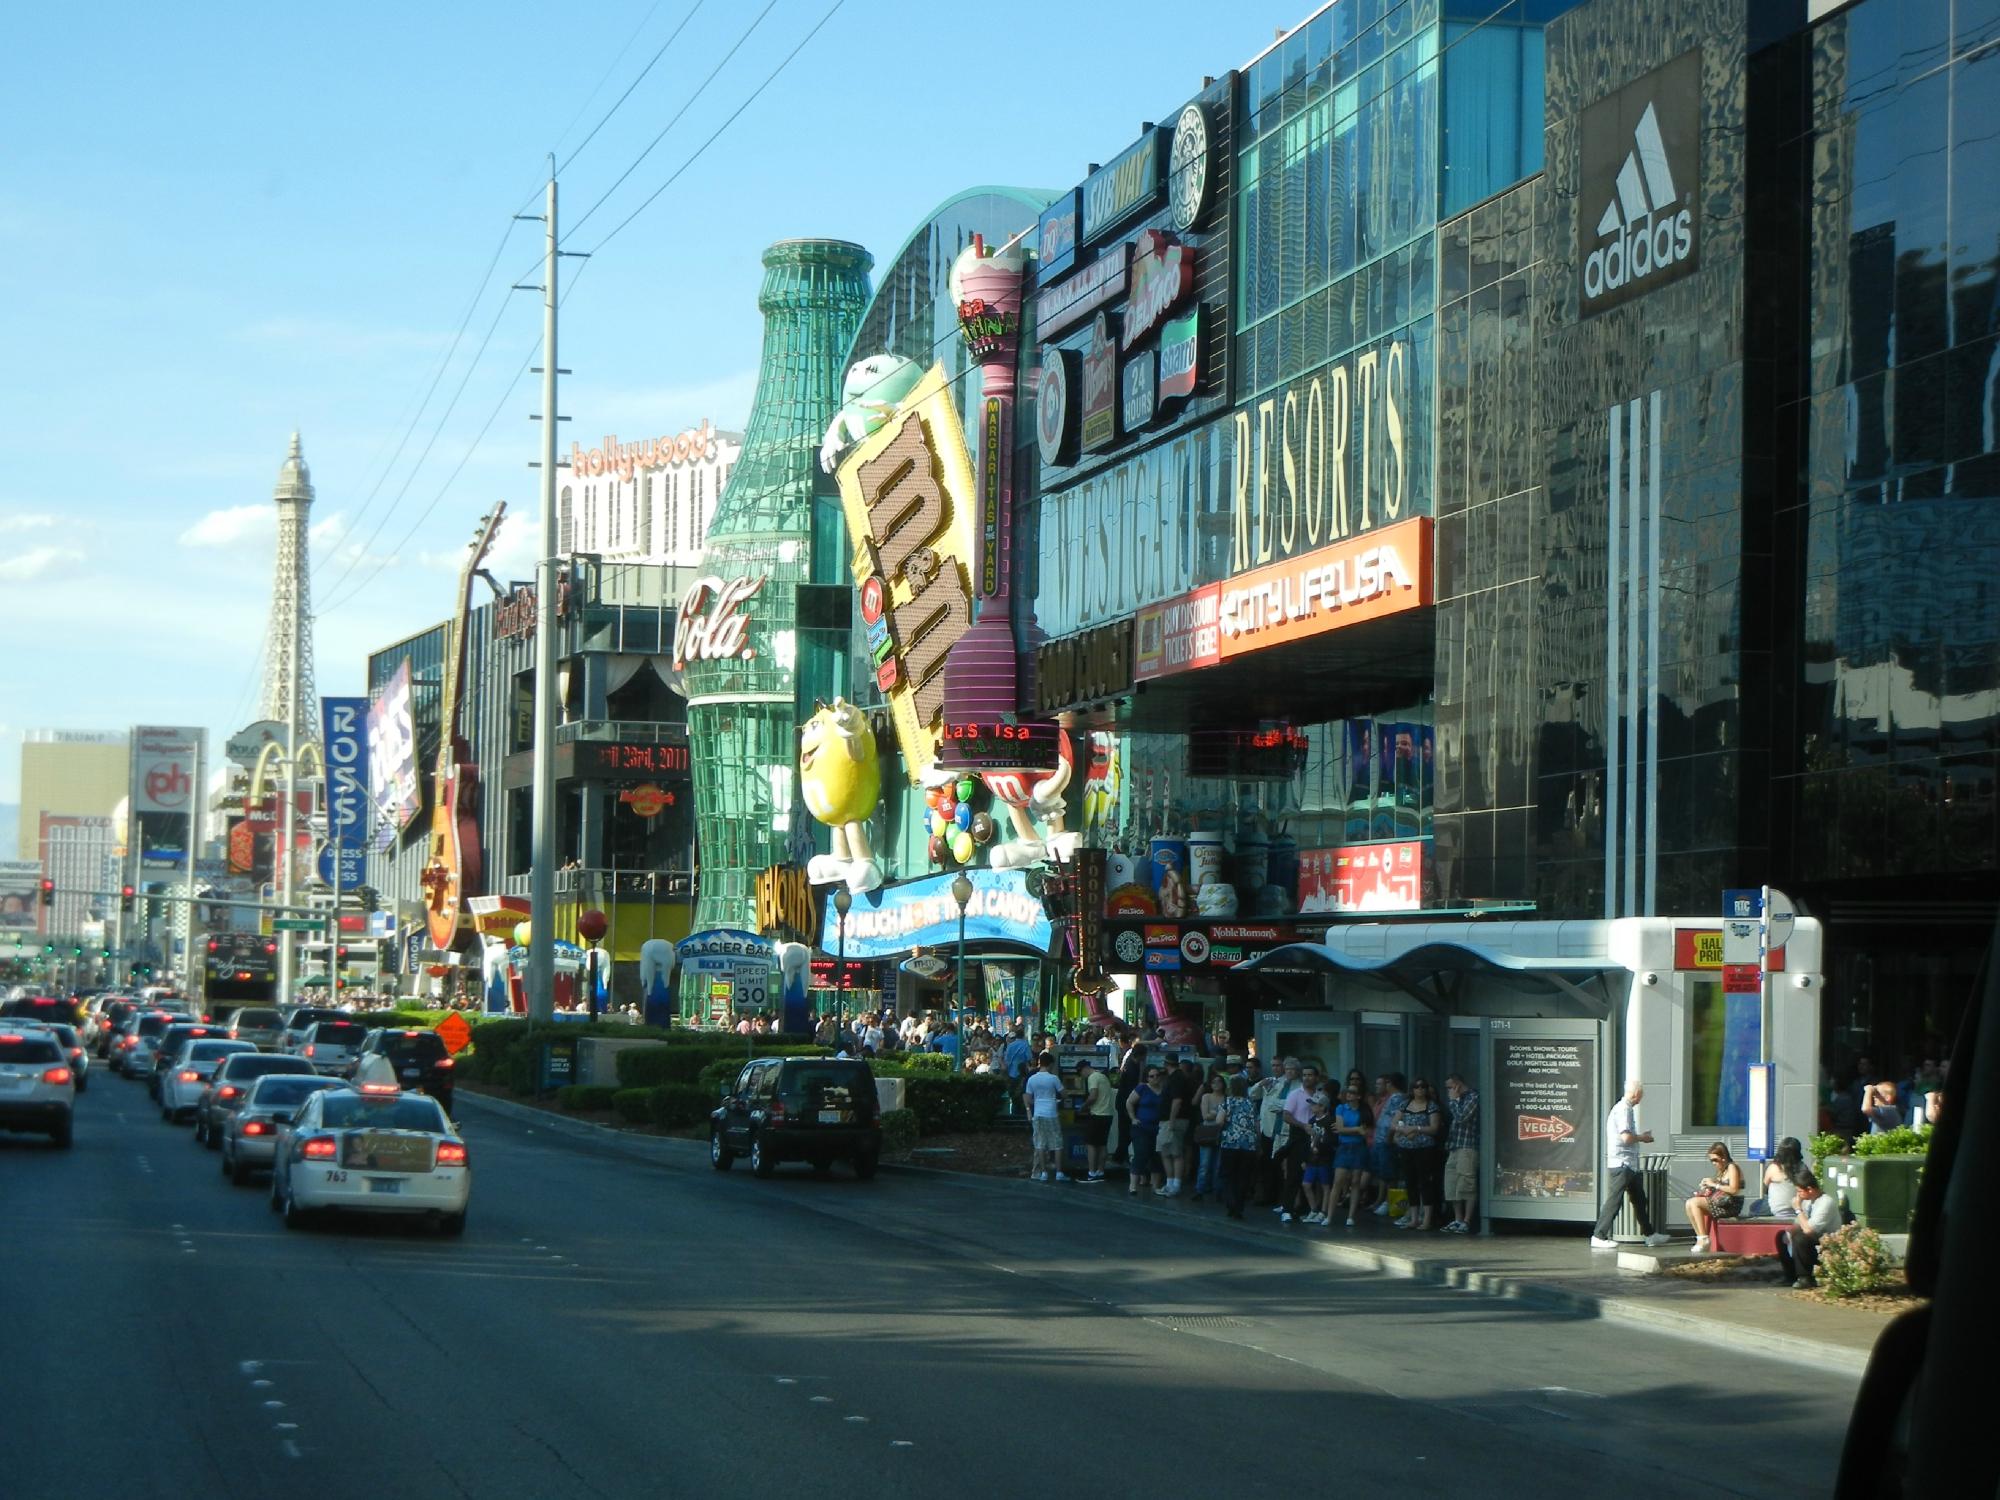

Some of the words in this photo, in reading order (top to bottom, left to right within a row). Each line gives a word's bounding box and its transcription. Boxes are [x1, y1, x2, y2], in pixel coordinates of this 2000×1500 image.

[1085, 143, 1152, 231] SUBWAY
[1584, 209, 1691, 298] adidas
[1132, 363, 1145, 396] 24
[1125, 391, 1151, 425] HOURS
[572, 418, 709, 483] hollywood
[986, 401, 998, 523] MARGARITAS
[1233, 340, 1404, 573] RESORTS
[1058, 430, 1213, 626] WESTGATE
[985, 543, 995, 592] YARD
[1164, 607, 1179, 634] BUY
[1180, 595, 1218, 631] DISCOUNT
[1165, 635, 1194, 665] TICKETS
[332, 706, 358, 825] ROSS
[659, 747, 688, 770] 2011
[327, 849, 363, 858] DESS
[1088, 851, 1098, 904] FOOD
[856, 907, 899, 936] MUCH
[901, 903, 942, 932] MORE
[986, 889, 1040, 926] CANDY
[1734, 900, 1750, 912] RTC
[1087, 911, 1097, 976] COURT
[1213, 927, 1238, 939] Noble
[1238, 926, 1277, 939] Roman's
[1701, 938, 1722, 949] HAL
[411, 936, 419, 971] ROSS
[680, 942, 743, 958] GLACIER
[1211, 949, 1241, 961] sbarro
[1700, 950, 1723, 962] PRIC
[737, 987, 765, 1003] 30
[1523, 1122, 1564, 1134] VEGAS
[326, 1171, 347, 1182] 763
